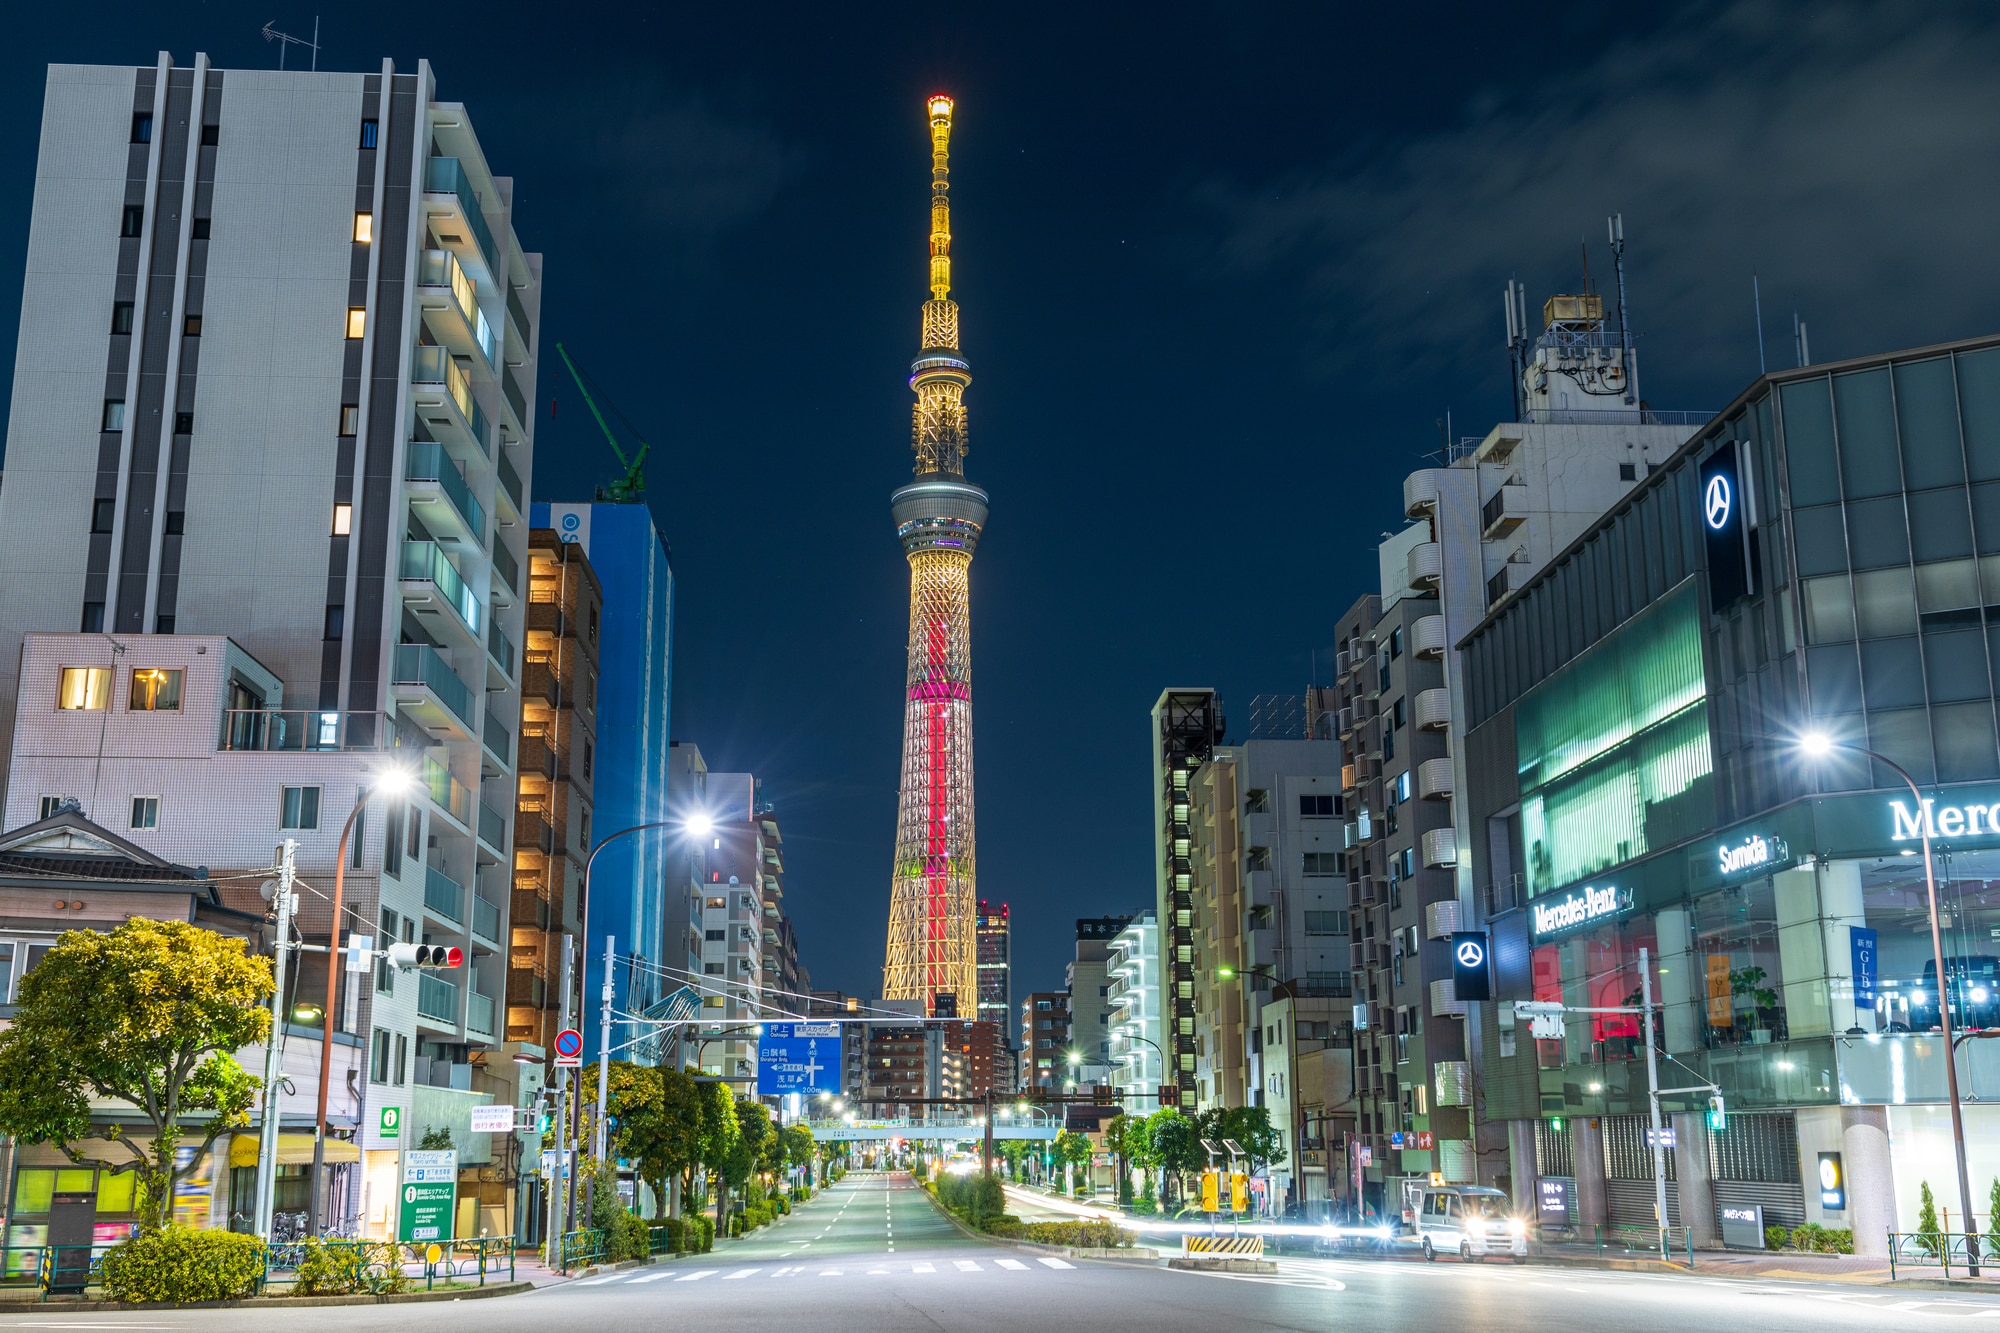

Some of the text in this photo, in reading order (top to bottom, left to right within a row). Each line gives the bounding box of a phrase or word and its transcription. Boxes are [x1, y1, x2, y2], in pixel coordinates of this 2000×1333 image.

[1719, 834, 1768, 874] Sumida
[1534, 886, 1617, 935] Mercedes-Benz
[1083, 923, 1122, 934] 岡本工
[1857, 938, 1873, 949] 新型
[1860, 950, 1871, 988] GLB
[770, 1024, 789, 1033] 押上
[777, 1075, 795, 1083] 浅草
[474, 1122, 510, 1130] 歩行者優先
[1543, 1183, 1555, 1194] IN
